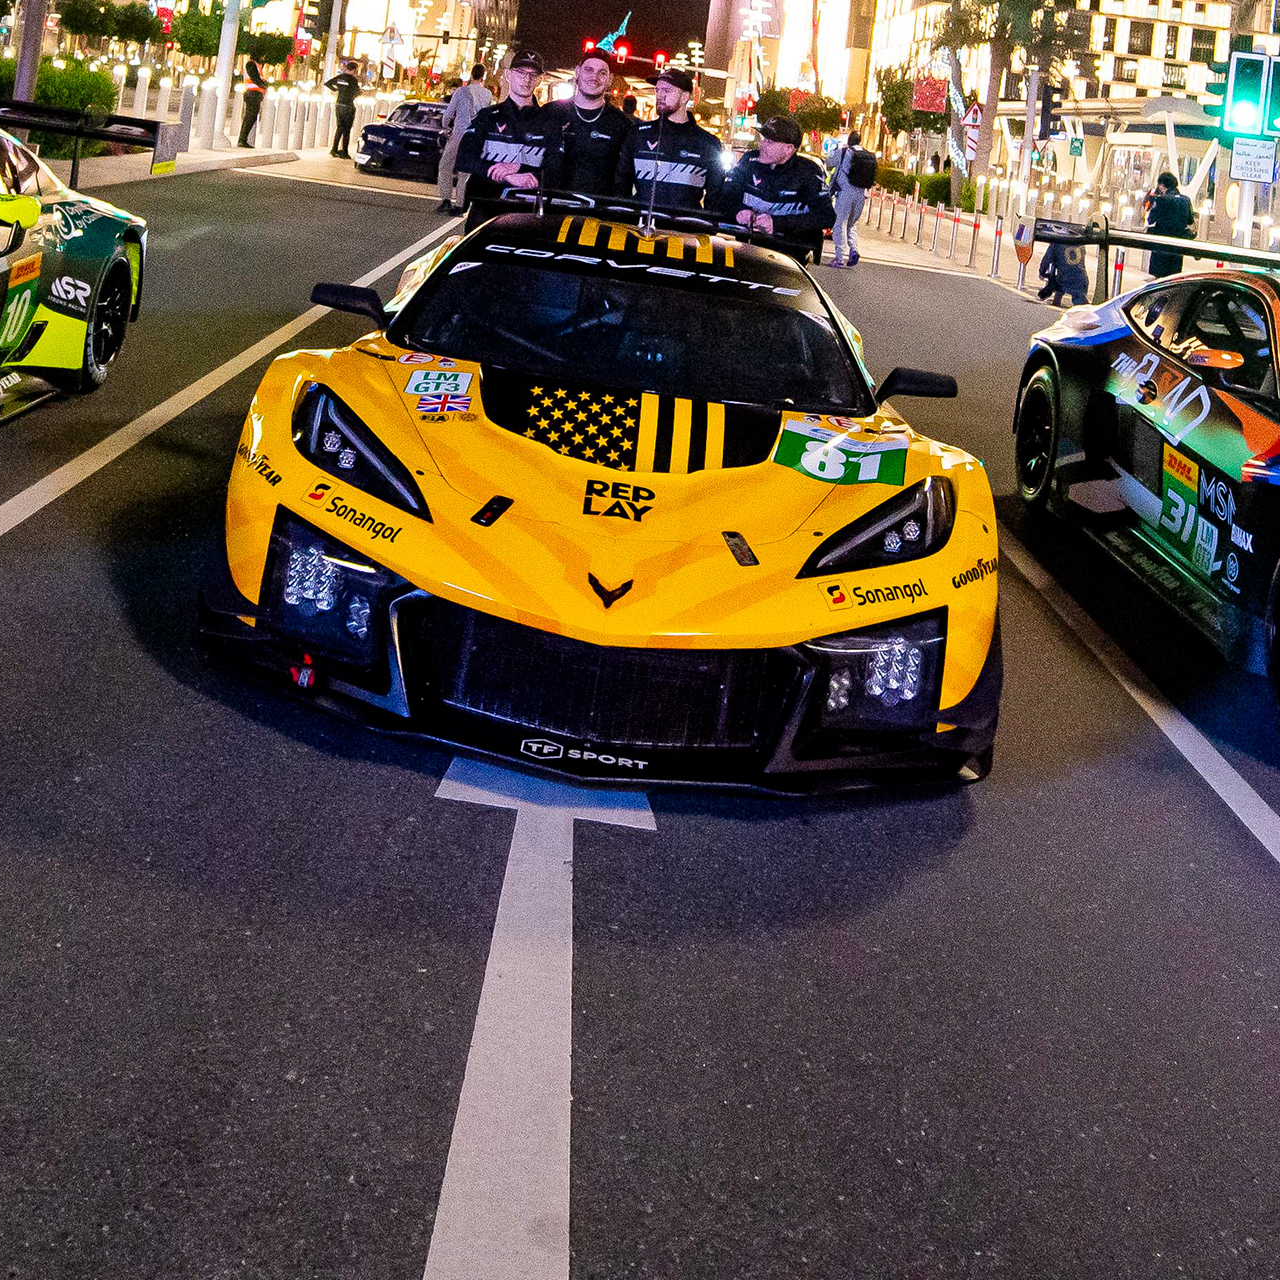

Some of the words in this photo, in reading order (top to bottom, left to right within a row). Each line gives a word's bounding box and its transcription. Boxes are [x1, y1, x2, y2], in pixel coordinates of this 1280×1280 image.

[1236, 165, 1269, 174] CROSSING
[484, 244, 802, 297] CORVETTE
[414, 381, 460, 393] GT3
[423, 372, 460, 381] LM
[800, 441, 882, 481] 81
[585, 479, 656, 503] REP
[325, 496, 403, 543] Sonangol
[582, 497, 654, 522] LAY
[1160, 488, 1196, 543] 31
[852, 578, 929, 607] Sonangol
[527, 742, 559, 756] TF
[567, 748, 649, 770] SPORT
